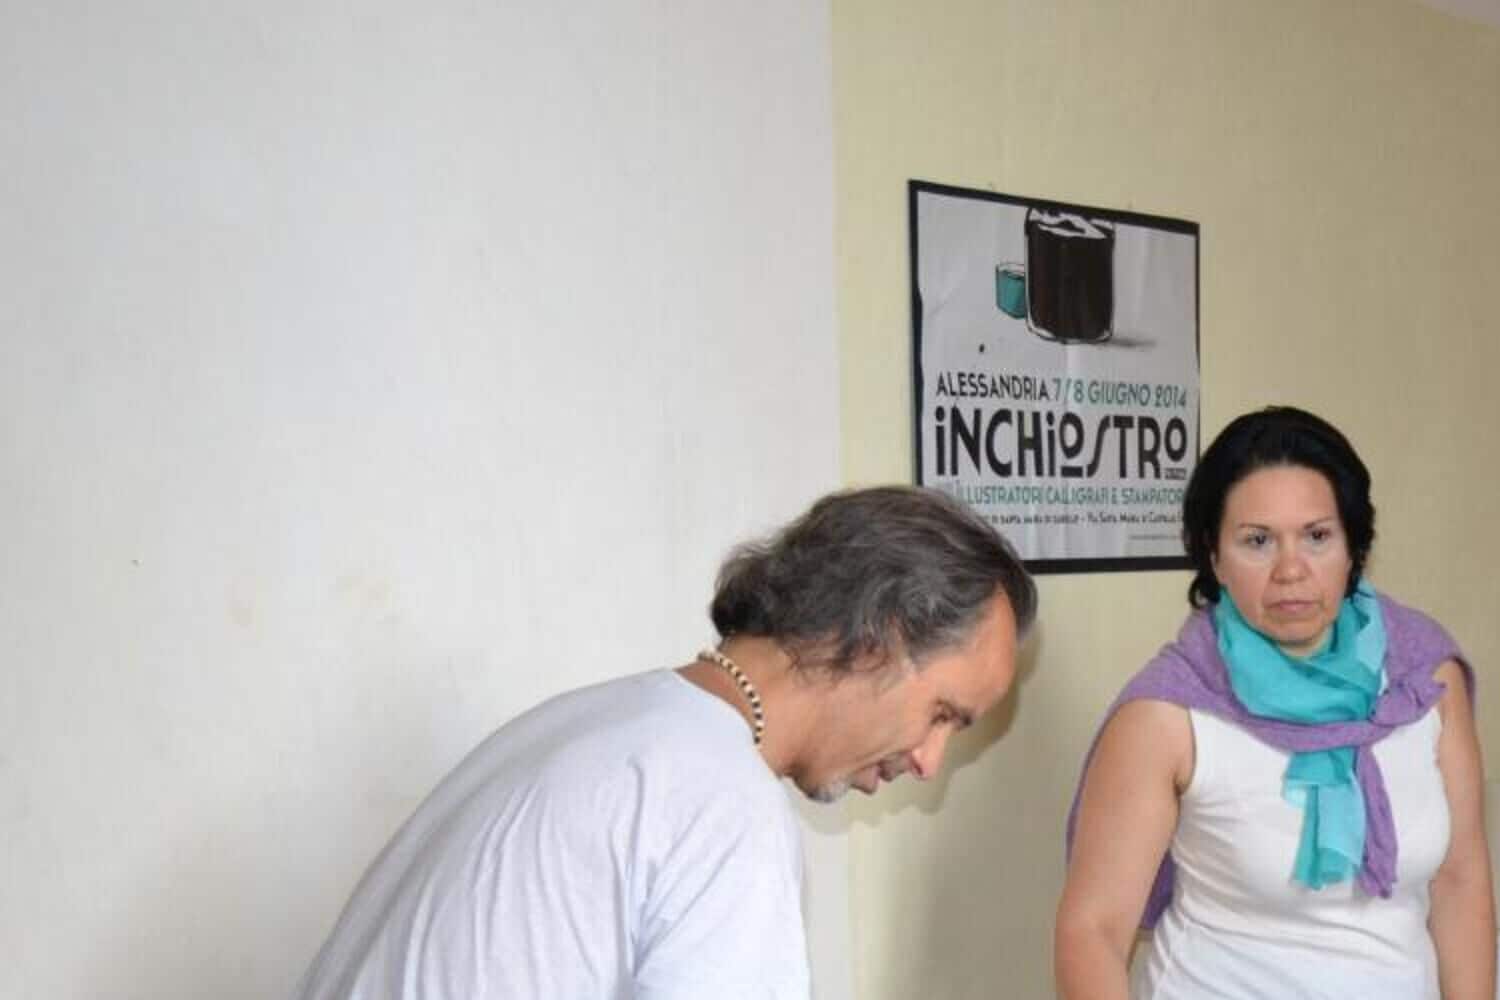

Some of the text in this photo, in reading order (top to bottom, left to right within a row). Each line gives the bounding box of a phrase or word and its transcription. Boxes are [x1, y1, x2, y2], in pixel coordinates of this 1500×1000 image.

[936, 371, 1049, 402] ALESSANDRIA
[1087, 381, 1152, 407] GIUGNO
[1154, 383, 1187, 409] 2014
[1120, 486, 1184, 506] STAMPATOR
